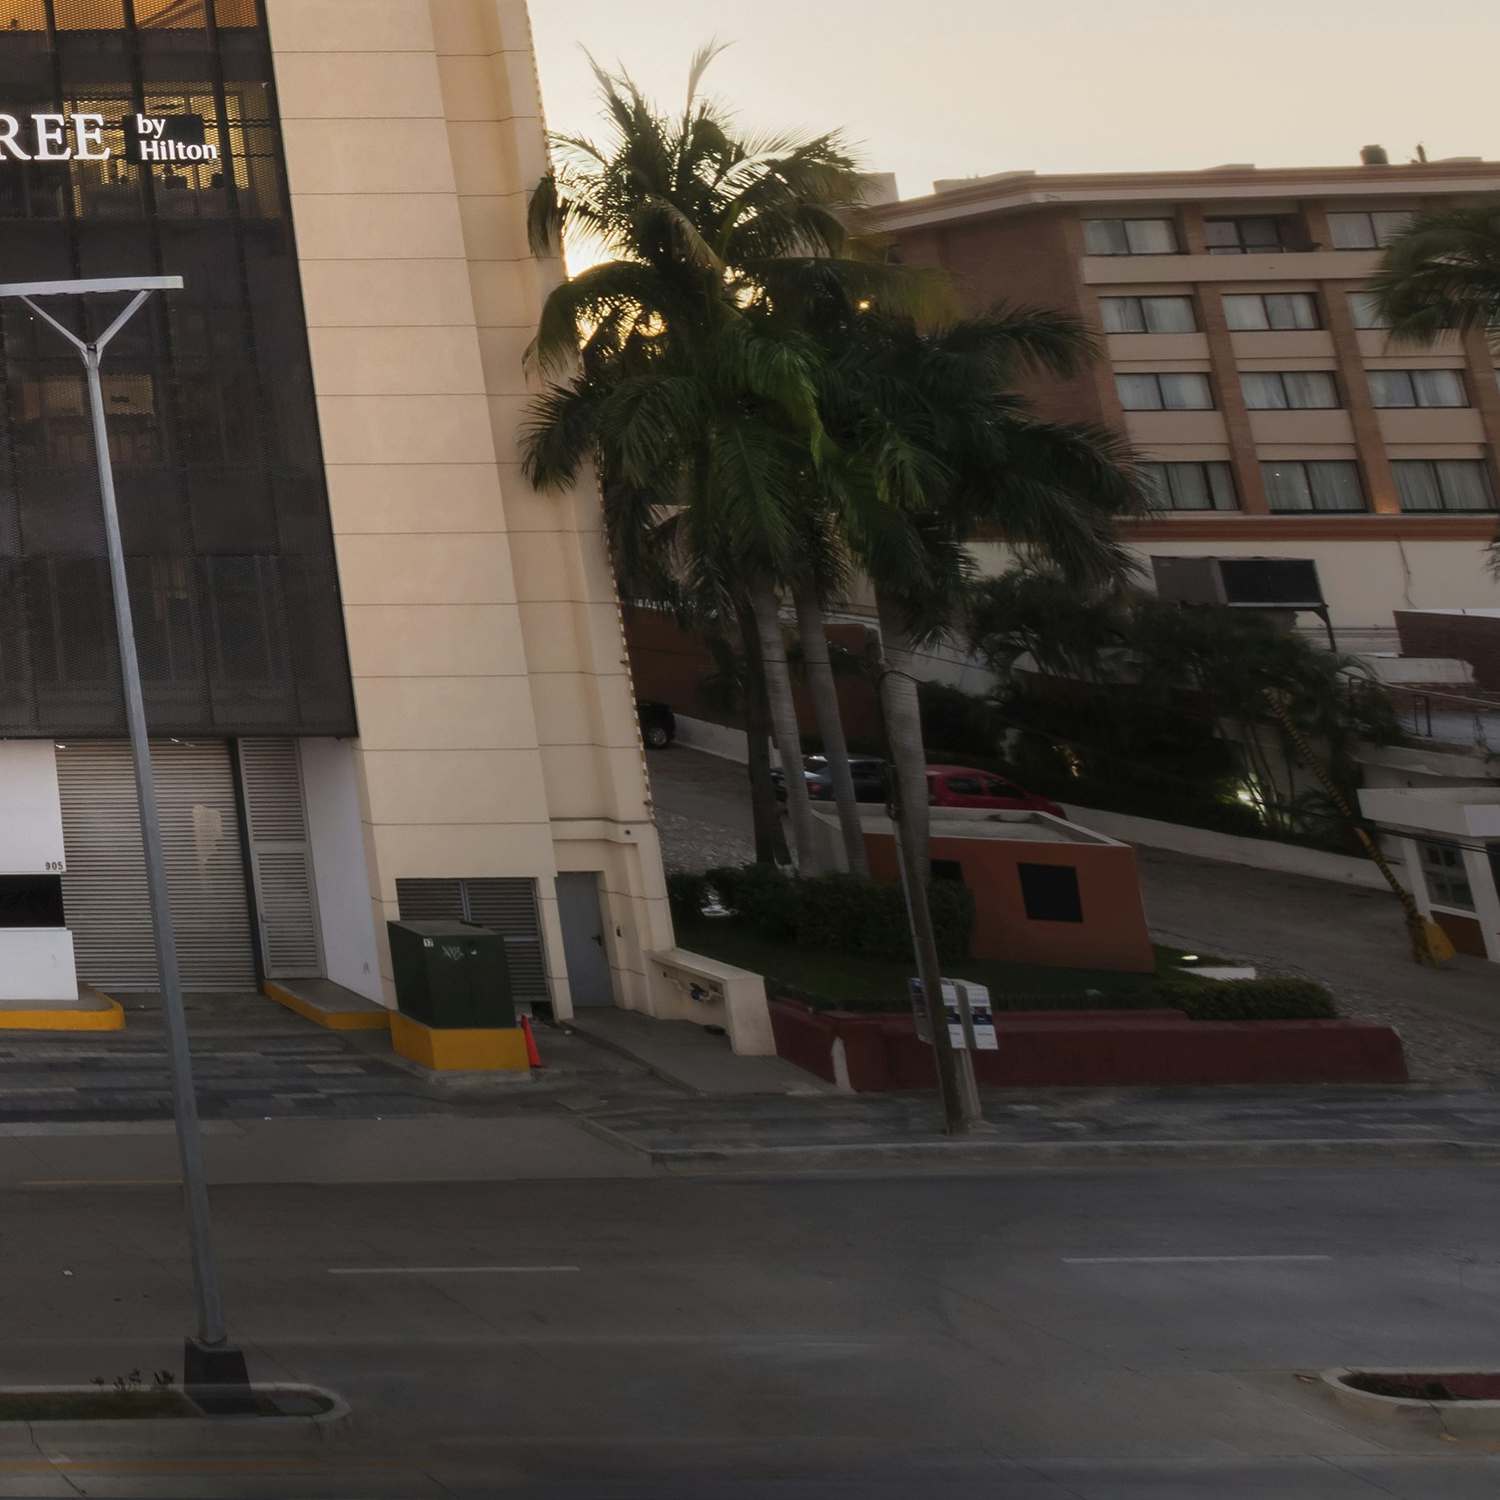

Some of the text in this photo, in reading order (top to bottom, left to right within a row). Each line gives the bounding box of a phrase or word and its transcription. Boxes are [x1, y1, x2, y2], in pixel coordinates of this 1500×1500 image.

[136, 113, 166, 140] by
[139, 139, 218, 161] Hilton
[45, 861, 64, 871] 905
